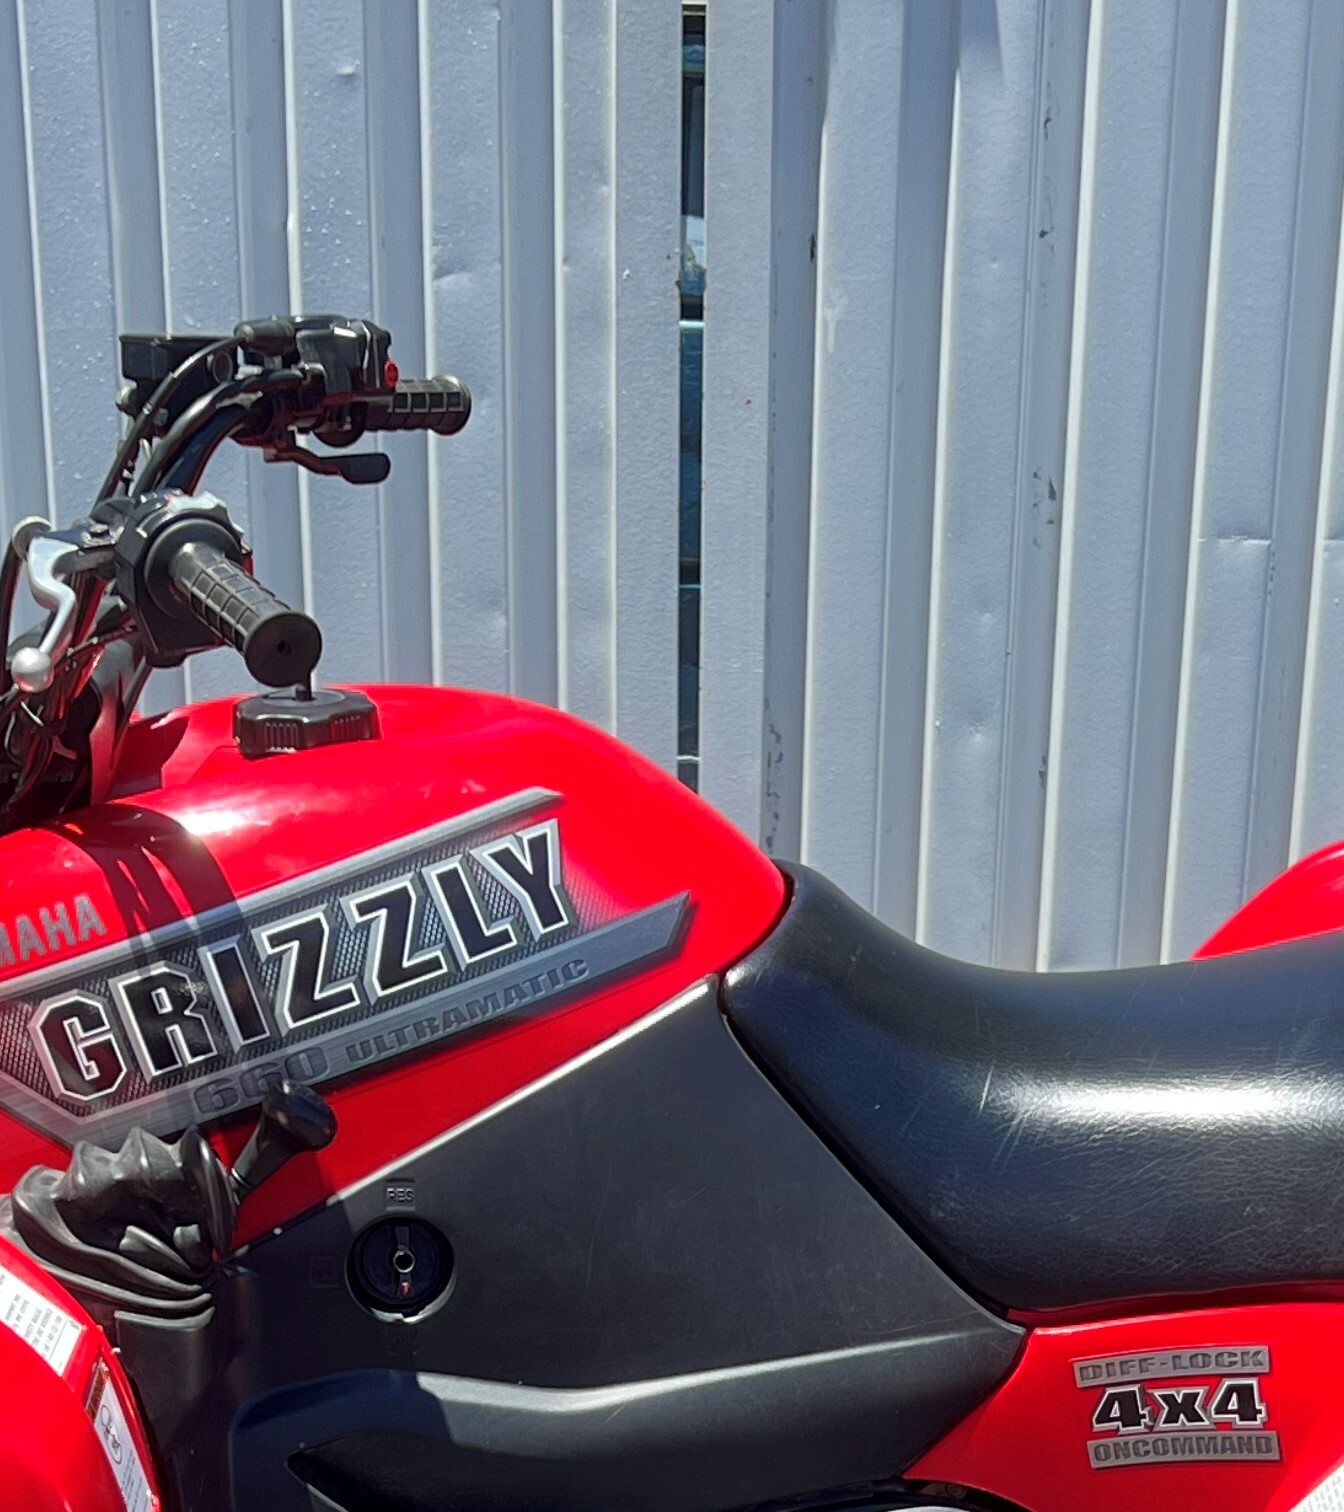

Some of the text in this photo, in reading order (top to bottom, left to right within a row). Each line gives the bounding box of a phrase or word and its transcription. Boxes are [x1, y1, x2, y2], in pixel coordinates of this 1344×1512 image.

[30, 820, 570, 1108] GRIZZLY
[193, 958, 591, 1115] 660 ULTRAMATIC
[1078, 1349, 1266, 1383] DIFF-LOCK
[1092, 1378, 1269, 1435] 4x4
[1092, 1434, 1274, 1463] ONCOMMAND
